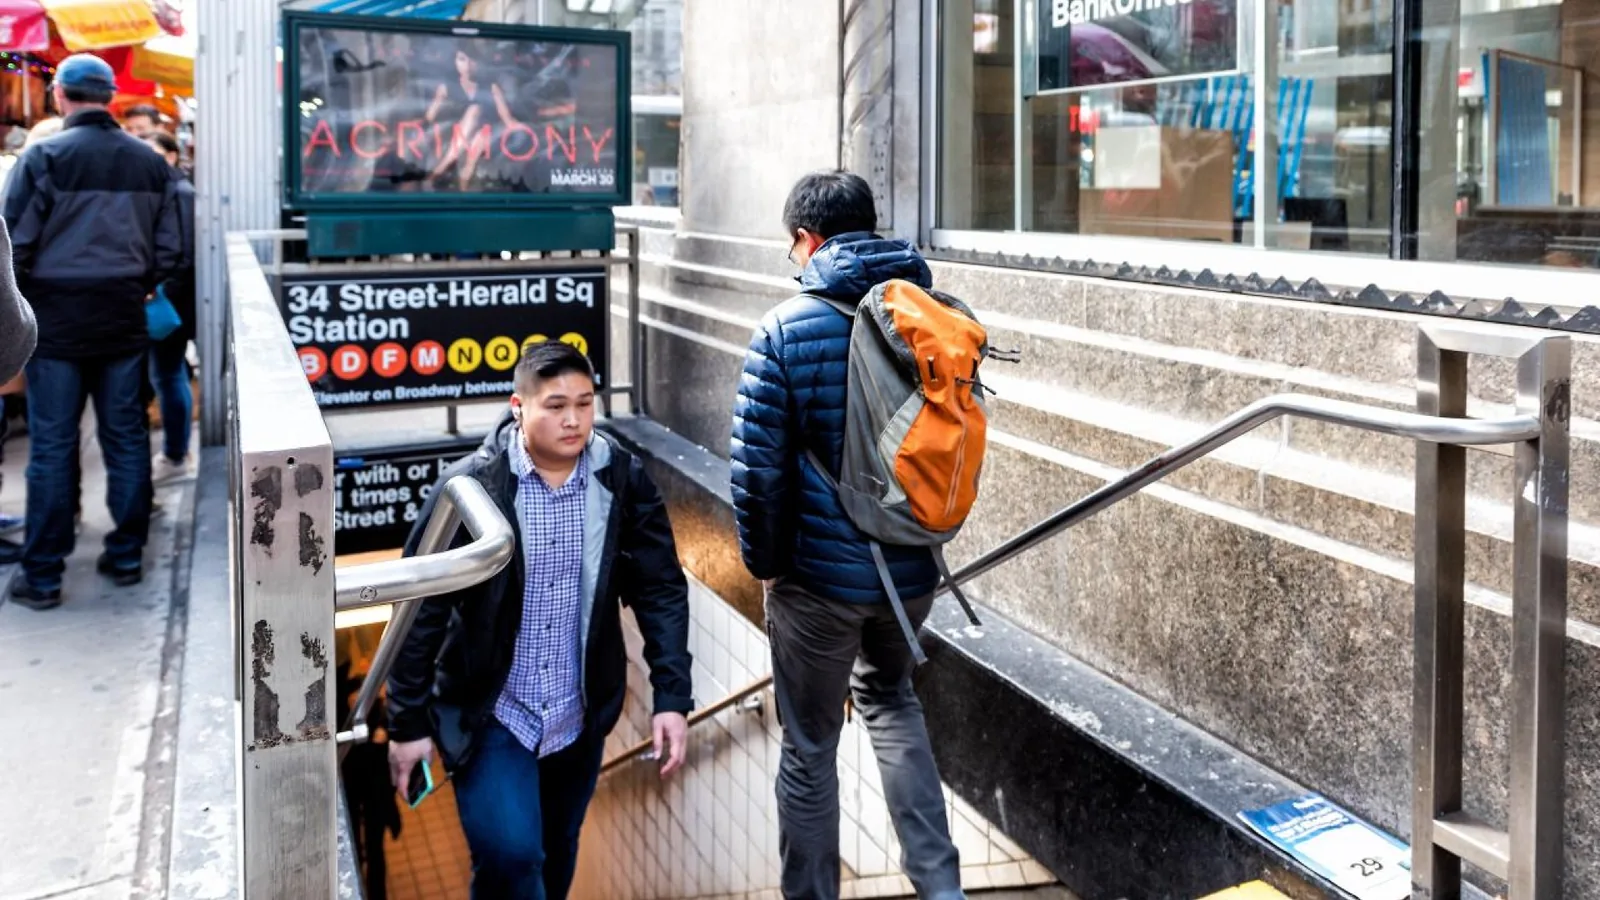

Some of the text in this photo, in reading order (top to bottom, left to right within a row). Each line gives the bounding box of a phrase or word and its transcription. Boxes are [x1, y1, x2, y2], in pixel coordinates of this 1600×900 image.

[303, 119, 613, 163] ACRIMONY
[550, 173, 615, 186] MARCH 30
[288, 277, 594, 312] 34 Street-Herald Sq
[290, 314, 409, 344] Station
[341, 351, 361, 373] D
[382, 349, 398, 370] F
[418, 346, 440, 367] M
[458, 346, 473, 364] N
[493, 344, 511, 363] Q
[373, 388, 392, 401] on
[396, 382, 462, 400] Broadway
[464, 380, 516, 394] betwee
[354, 464, 399, 485] with
[407, 464, 431, 481] or
[352, 486, 411, 506] times
[335, 502, 418, 529] Street &
[1350, 857, 1383, 877] 29
